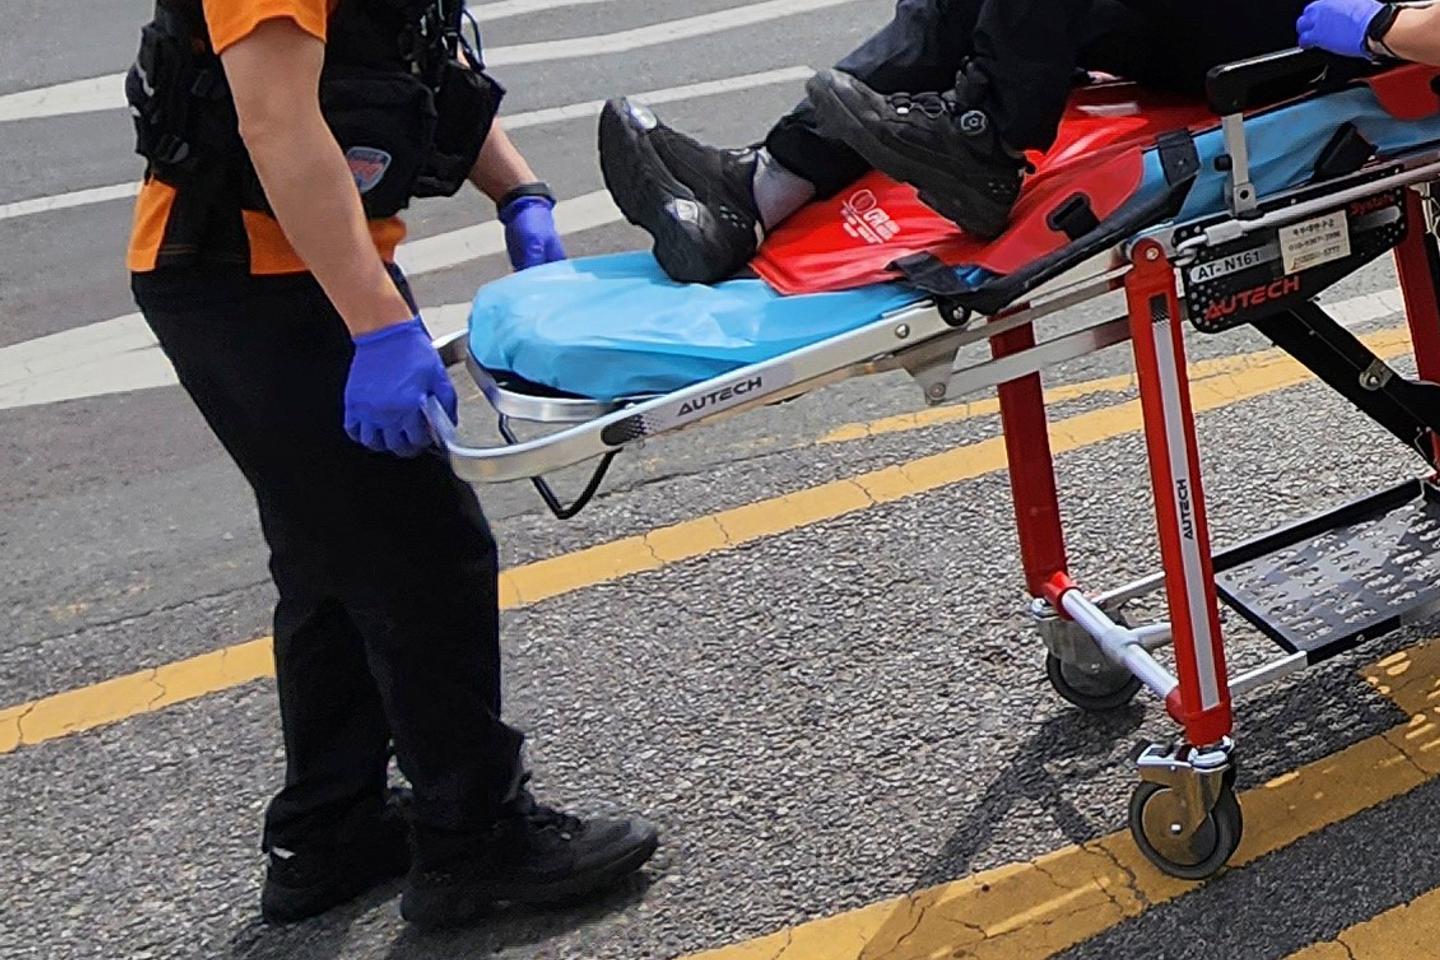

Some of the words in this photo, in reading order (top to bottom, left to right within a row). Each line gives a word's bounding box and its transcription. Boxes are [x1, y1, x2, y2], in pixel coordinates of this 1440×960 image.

[1203, 275, 1300, 321] AUTECH
[677, 376, 763, 417] AUTECH
[1176, 478, 1194, 540] AUTECH
